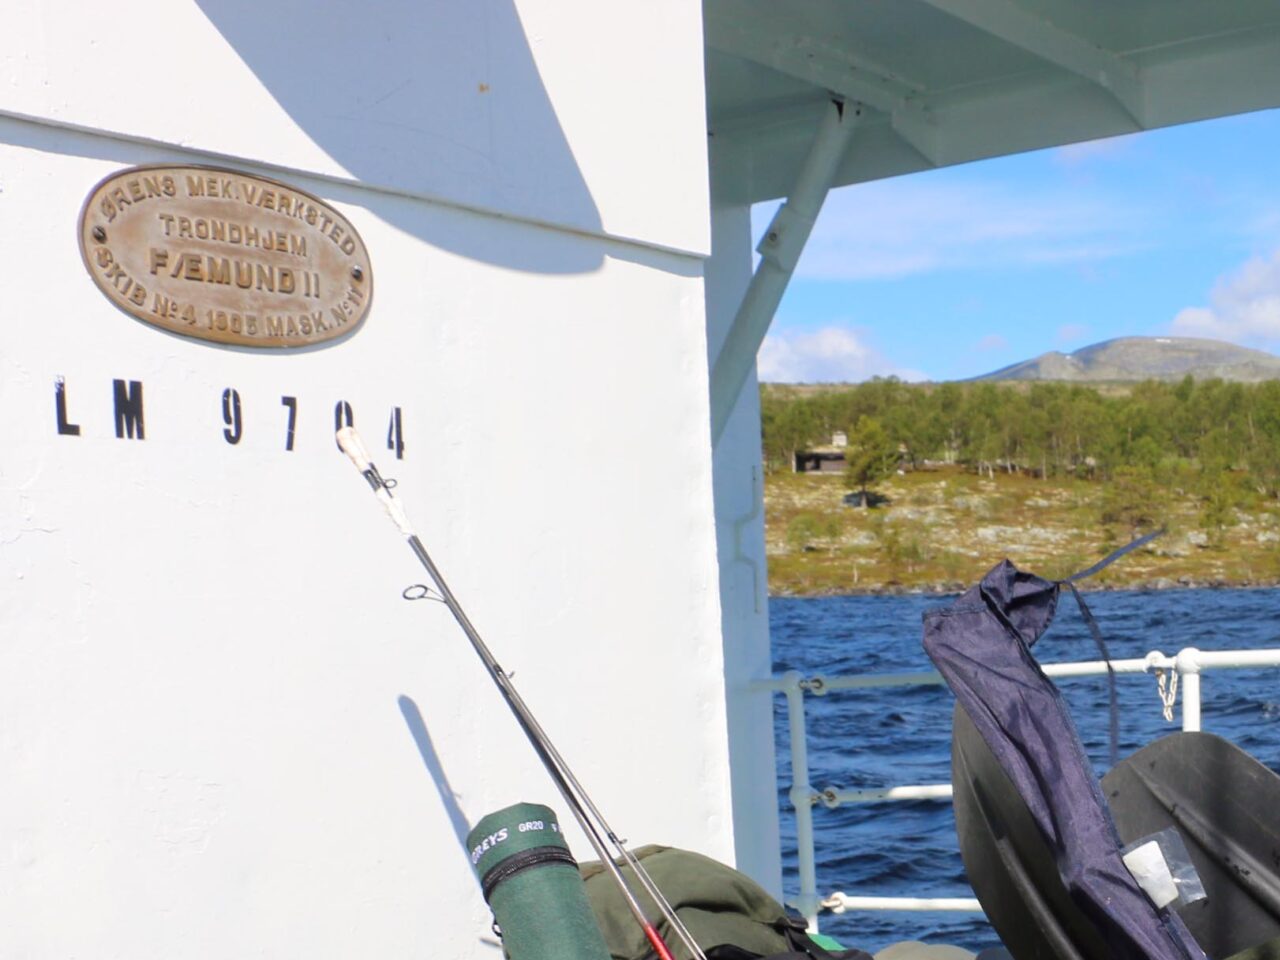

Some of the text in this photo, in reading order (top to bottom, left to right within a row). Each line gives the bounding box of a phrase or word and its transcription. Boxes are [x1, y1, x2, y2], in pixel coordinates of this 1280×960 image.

[99, 175, 177, 223] ØRENS
[158, 212, 307, 258] TRONDHJEM
[94, 246, 148, 307] SKIB
[149, 247, 296, 295] FÆMUND
[518, 820, 544, 833] GR20
